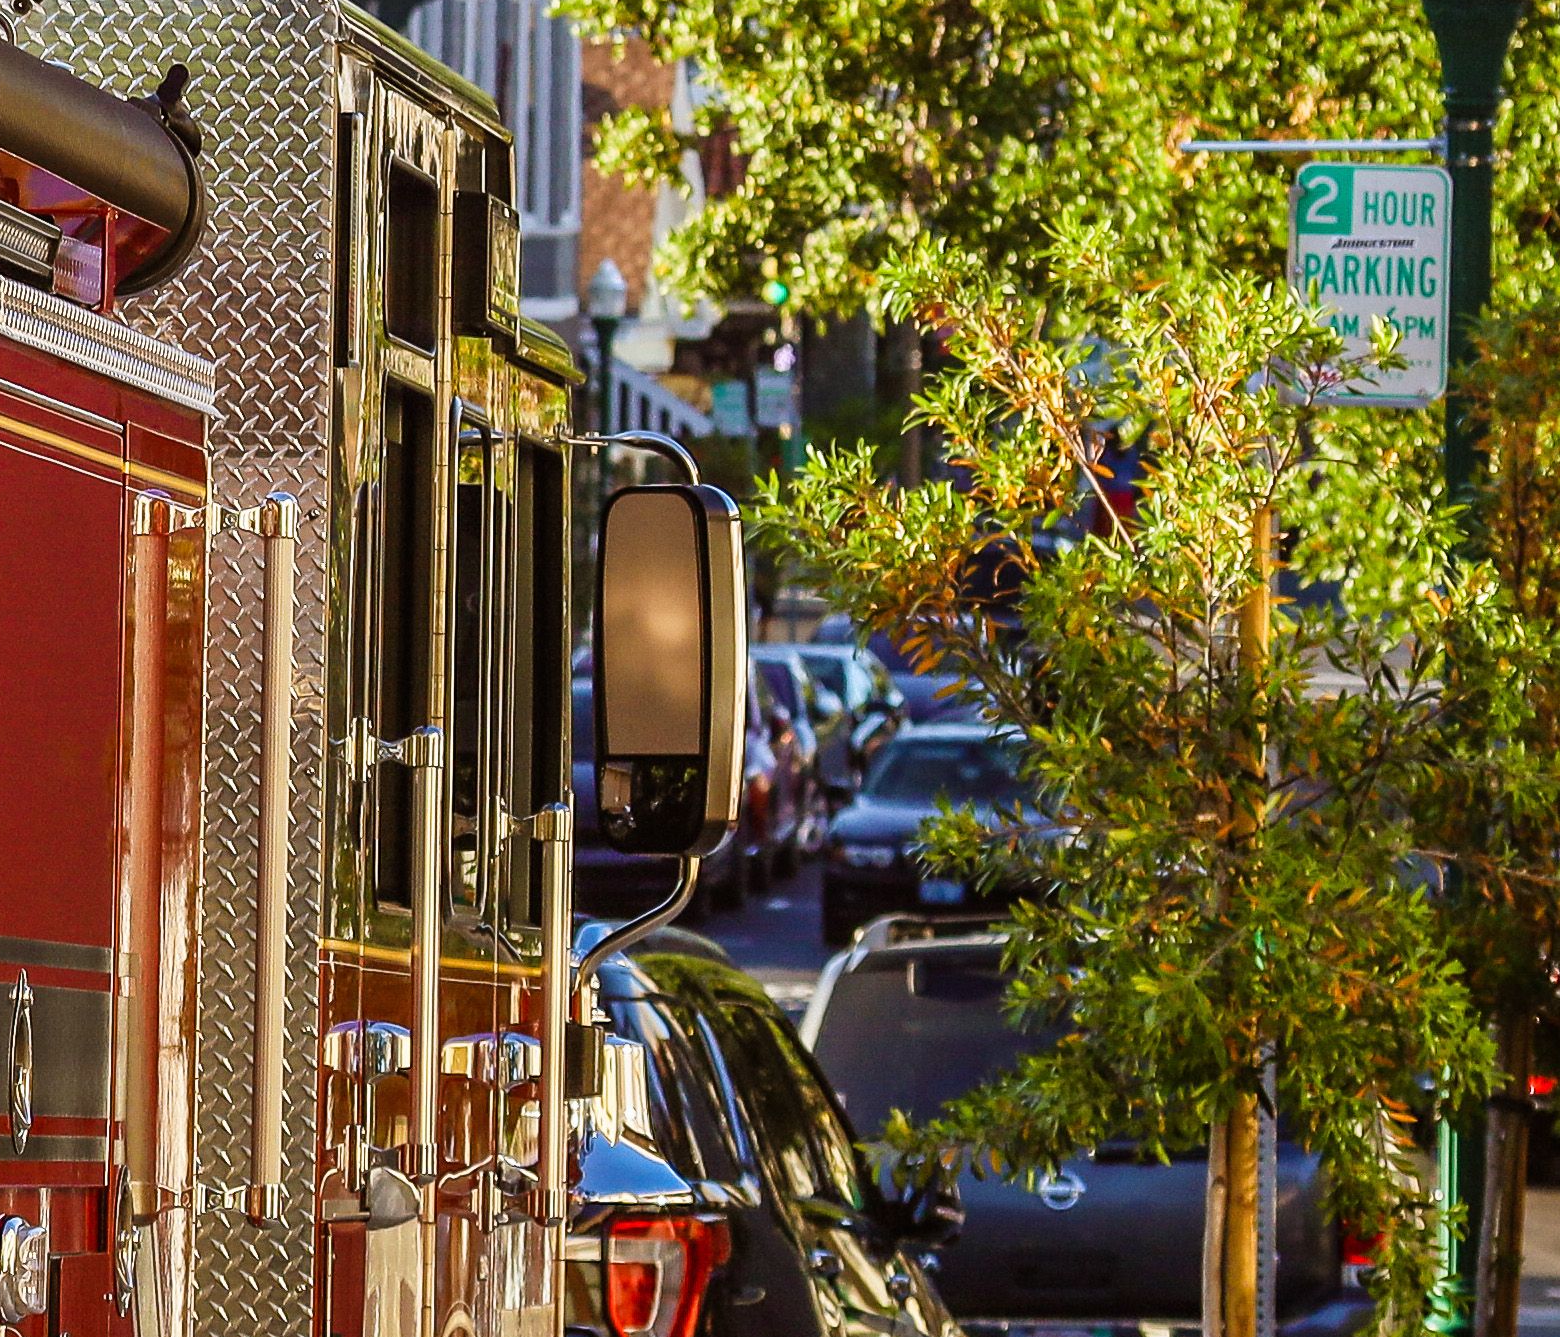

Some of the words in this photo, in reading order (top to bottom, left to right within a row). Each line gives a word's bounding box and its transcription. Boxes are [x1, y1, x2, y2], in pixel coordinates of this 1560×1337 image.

[1306, 175, 1339, 224] 2
[1364, 191, 1435, 227] HOUR
[1304, 253, 1436, 298] PARKING
